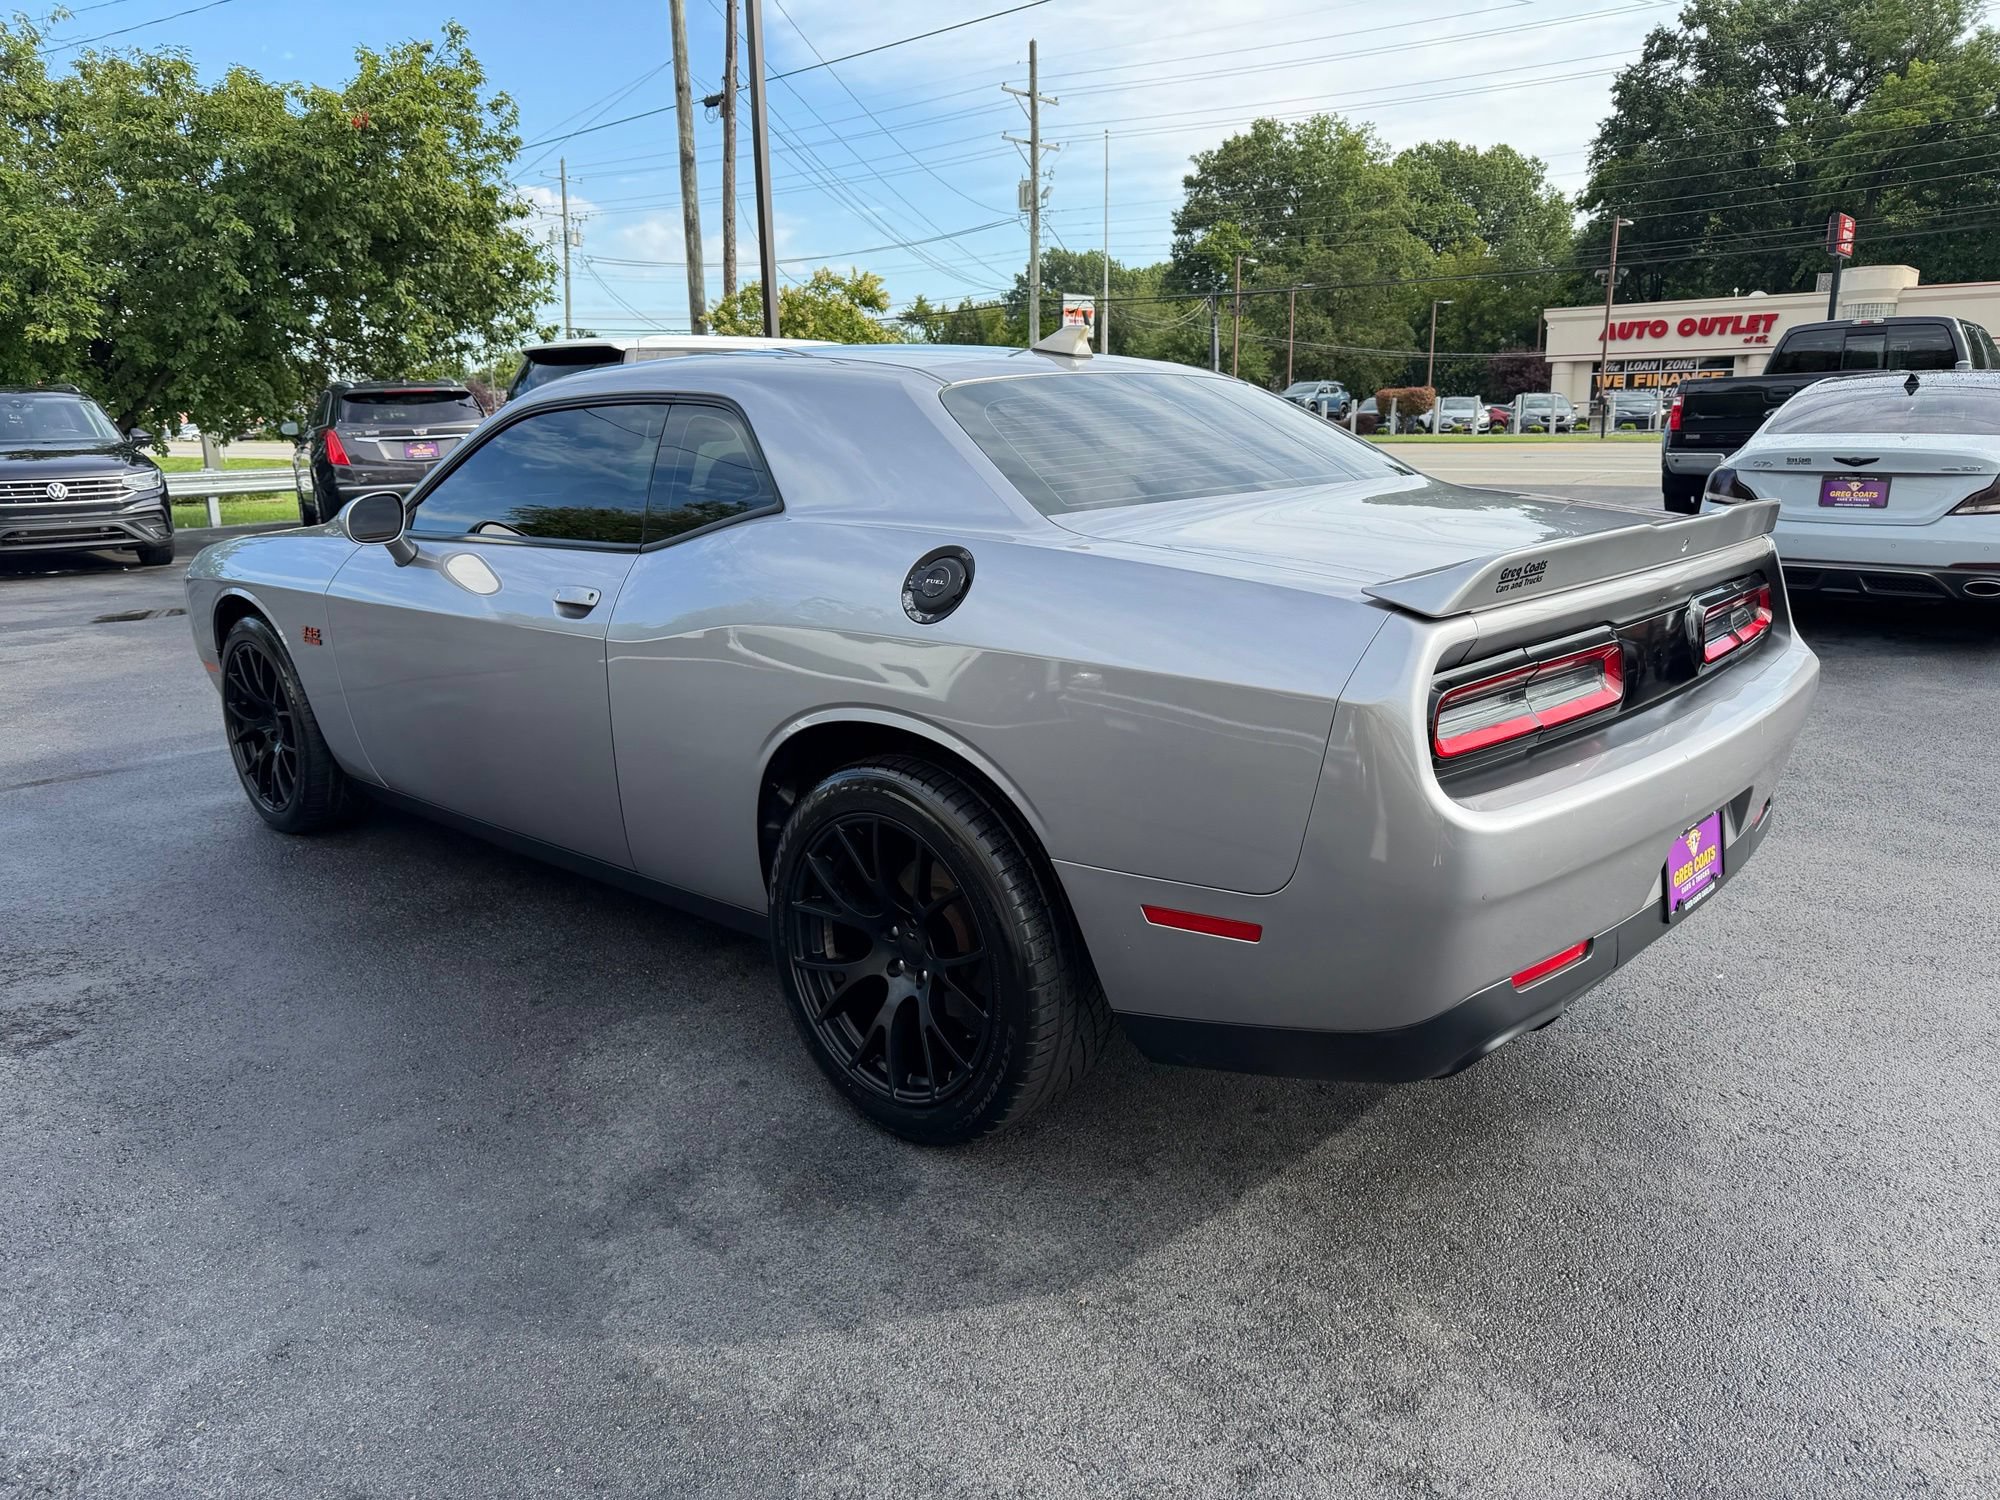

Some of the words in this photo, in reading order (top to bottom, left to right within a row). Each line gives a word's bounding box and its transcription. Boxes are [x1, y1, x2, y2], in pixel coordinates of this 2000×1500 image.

[1599, 319, 1668, 341] AUTO
[1677, 313, 1779, 337] OUTLET
[1627, 361, 1658, 372] LOAN
[1664, 360, 1695, 370] ZONE
[1596, 375, 1624, 388] WE
[1829, 490, 1852, 498] GREG
[1500, 567, 1523, 582] Greg
[1524, 559, 1548, 575] Coats
[1495, 584, 1510, 594] Cars
[1510, 579, 1523, 591] and
[1524, 574, 1543, 587] Trucks
[1673, 861, 1693, 888] GREG
[1694, 845, 1716, 872] COATS
